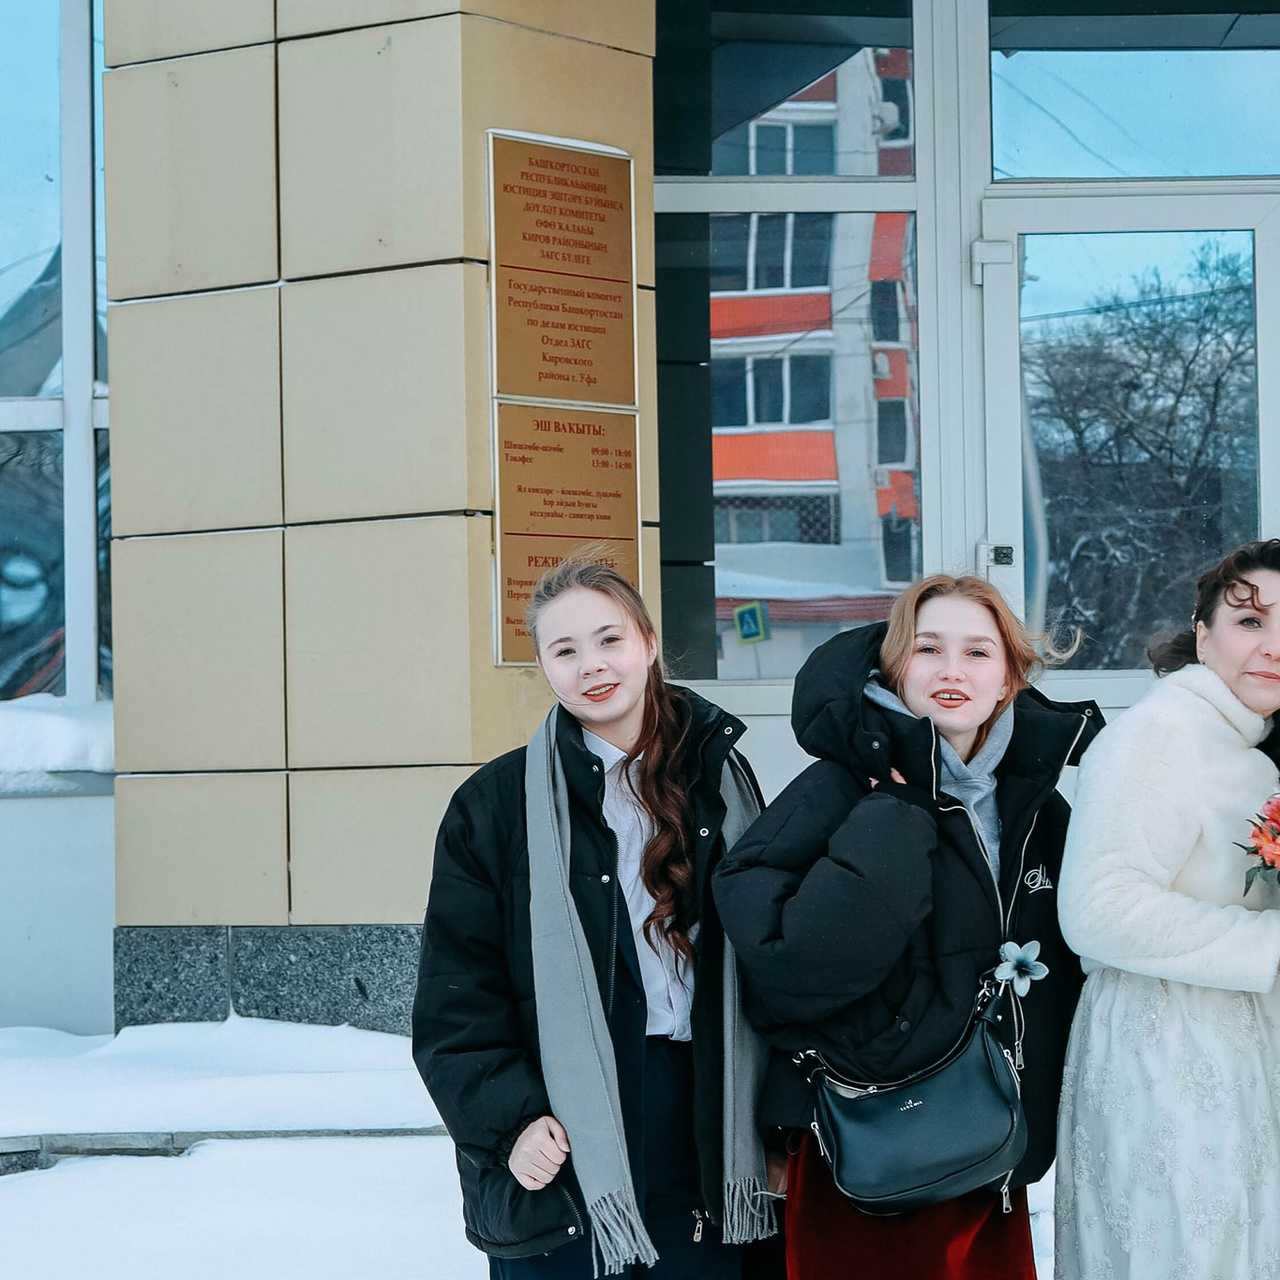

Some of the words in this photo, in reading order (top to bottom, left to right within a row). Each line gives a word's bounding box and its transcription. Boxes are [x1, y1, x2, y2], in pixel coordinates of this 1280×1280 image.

[502, 183, 548, 199] ЮСТИЦИЯ
[559, 208, 606, 222] КОМИТЕТЫ
[522, 232, 551, 244] КИРОВ
[540, 250, 561, 261] ЗАГС
[508, 279, 585, 298] Государственный
[586, 290, 622, 303] комитет
[508, 296, 560, 312] Республики
[561, 303, 623, 319] Башкортостан
[527, 318, 539, 327] по
[540, 320, 566, 330] делам
[567, 323, 606, 335] юстиции
[541, 335, 569, 347] Отдел
[570, 338, 593, 350] ЗАГС
[542, 352, 593, 367] Кировского
[538, 370, 570, 382] района
[532, 420, 551, 431] ЭШ
